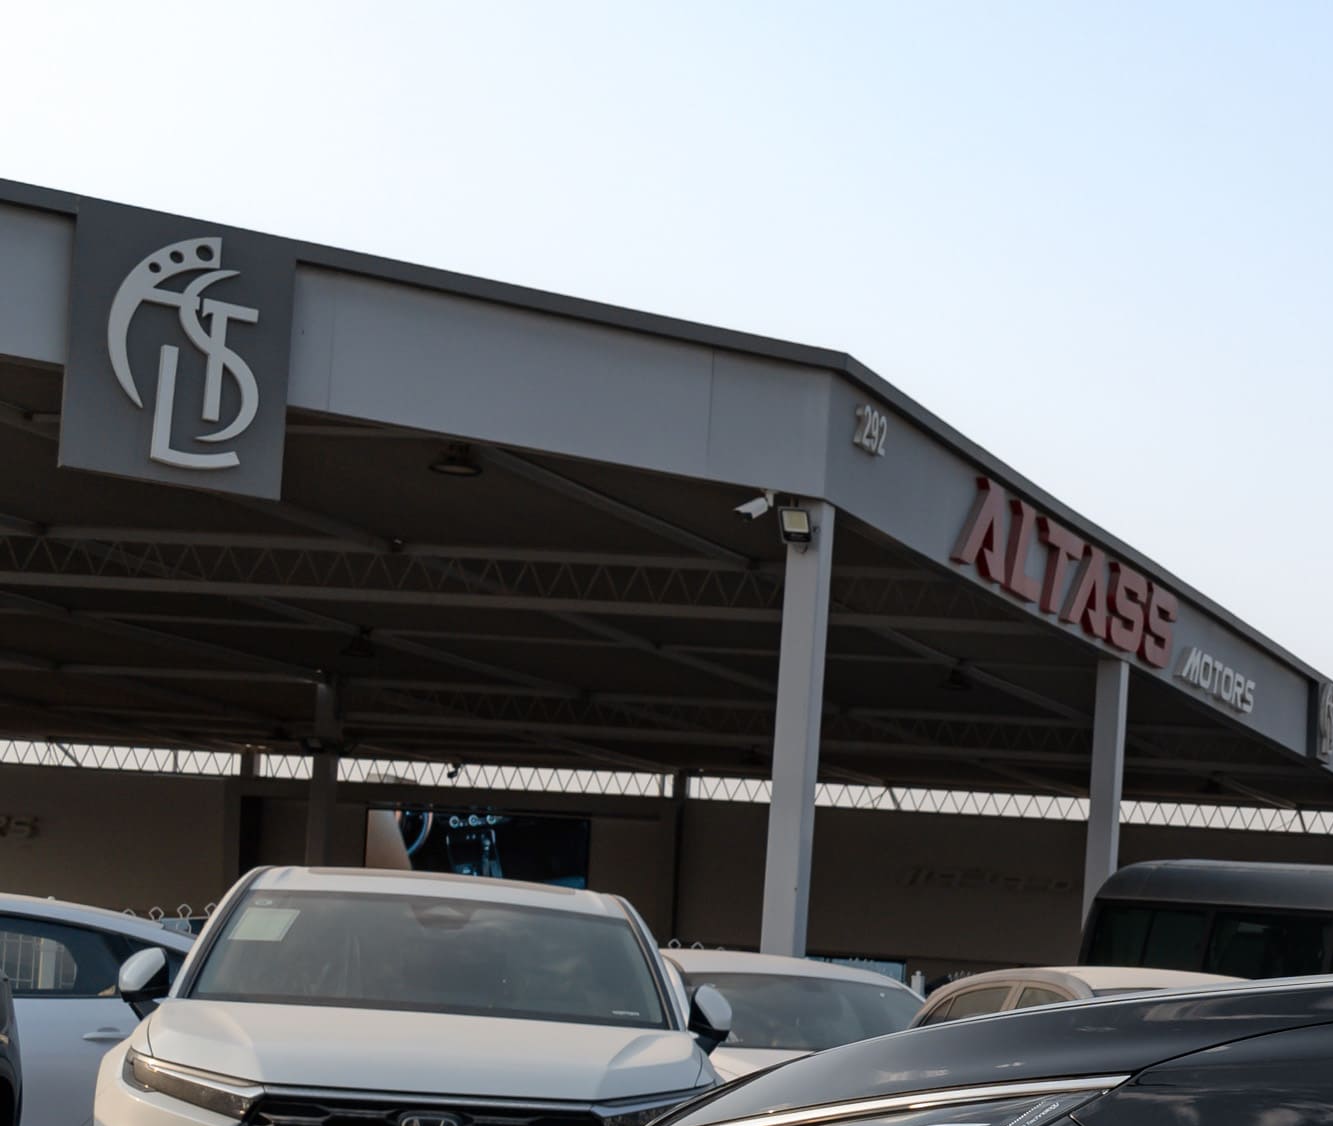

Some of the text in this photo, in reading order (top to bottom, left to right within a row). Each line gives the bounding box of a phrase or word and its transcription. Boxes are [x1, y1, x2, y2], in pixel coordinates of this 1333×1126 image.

[856, 404, 888, 456] 292
[951, 476, 1256, 714] ALTASS MOTORS
